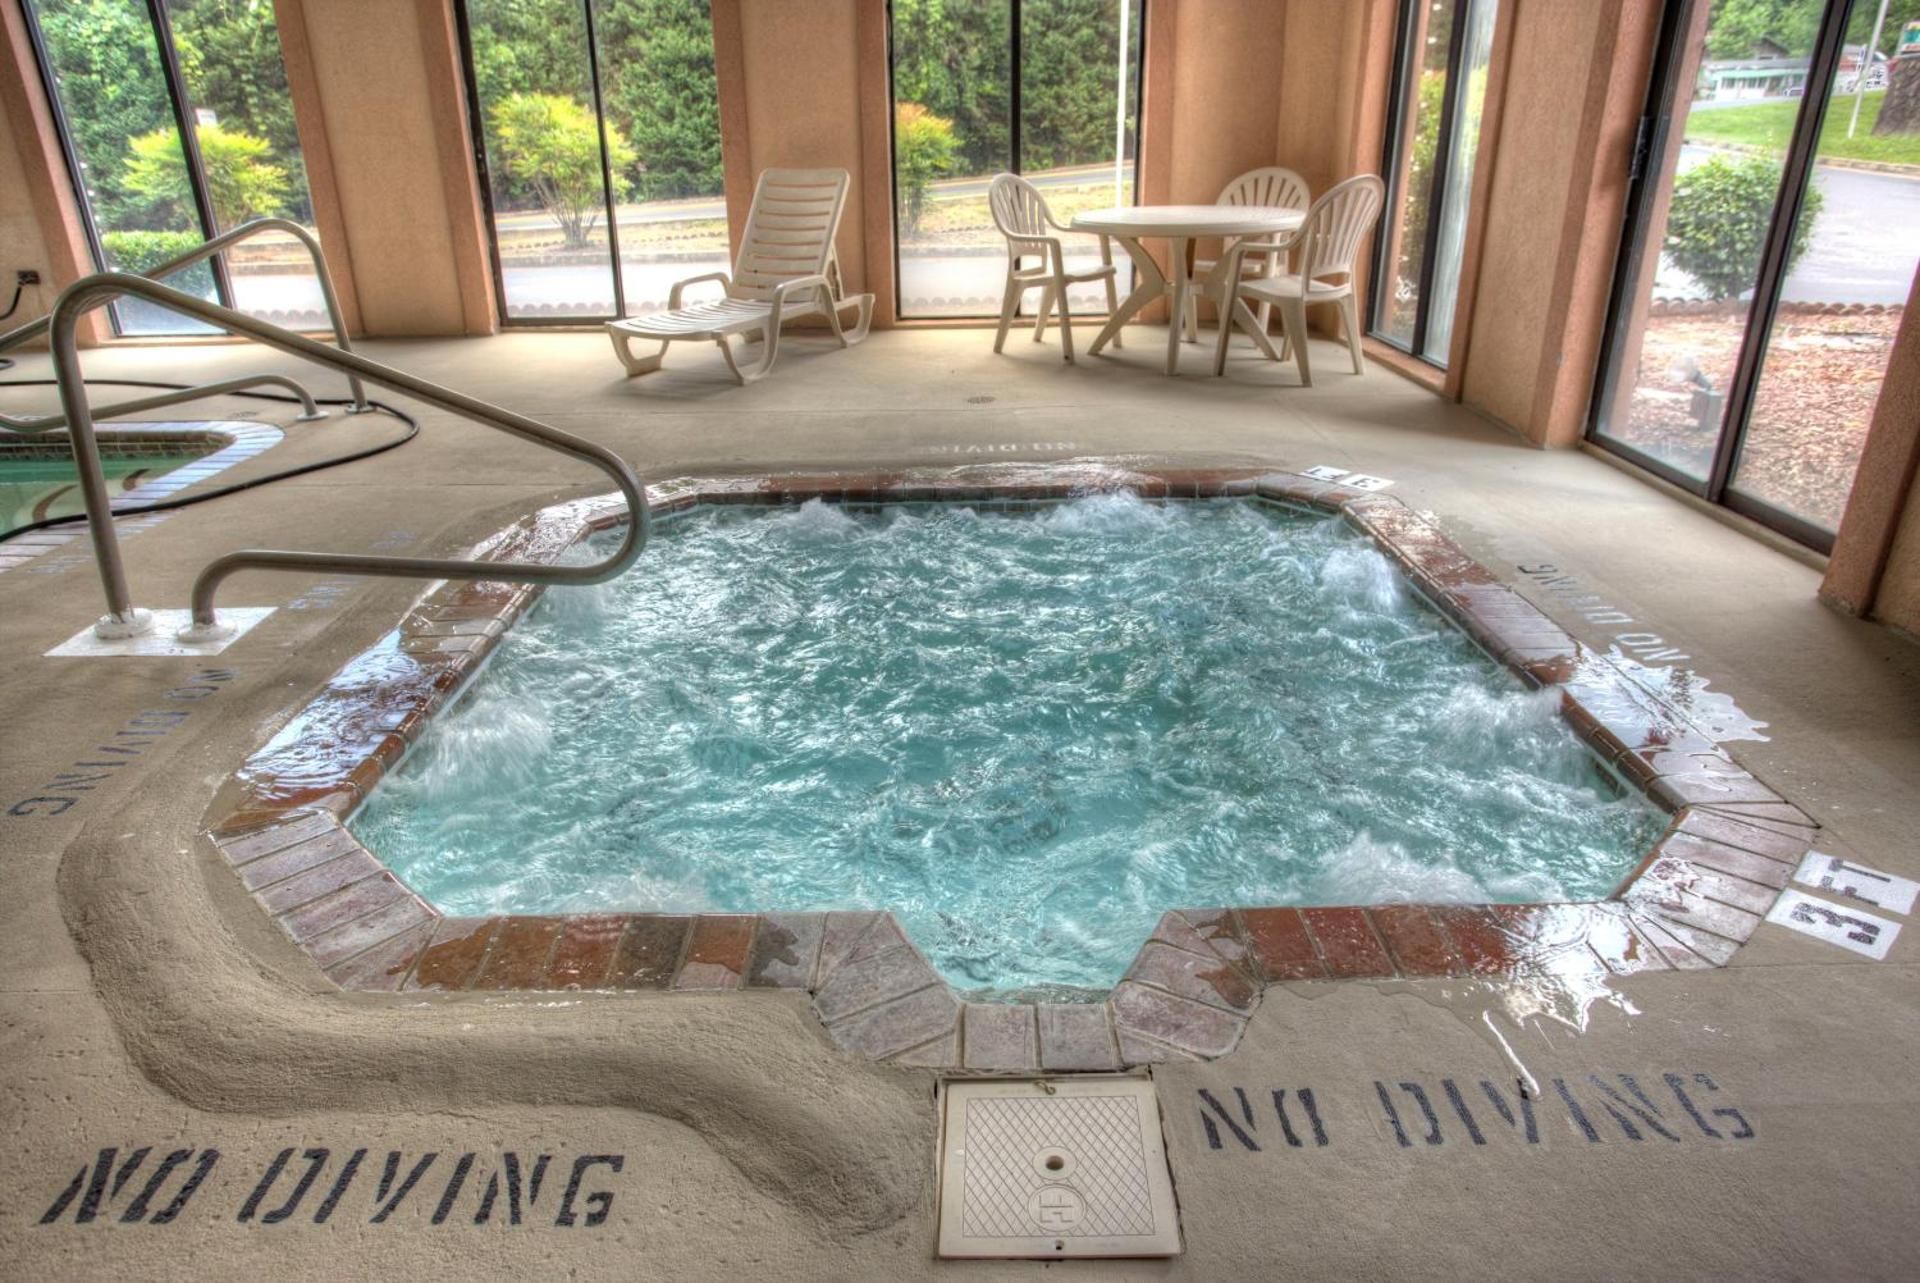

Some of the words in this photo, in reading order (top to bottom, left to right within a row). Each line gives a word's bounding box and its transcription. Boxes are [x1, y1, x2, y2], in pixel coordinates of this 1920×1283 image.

[1615, 631, 1692, 661] NO
[8, 711, 190, 817] DIVING
[1790, 902, 1881, 946] 3
[1198, 1086, 1328, 1151] NO
[1374, 1072, 1755, 1145] DIVING
[40, 1146, 220, 1225] NO
[237, 1147, 625, 1227] DIVING
